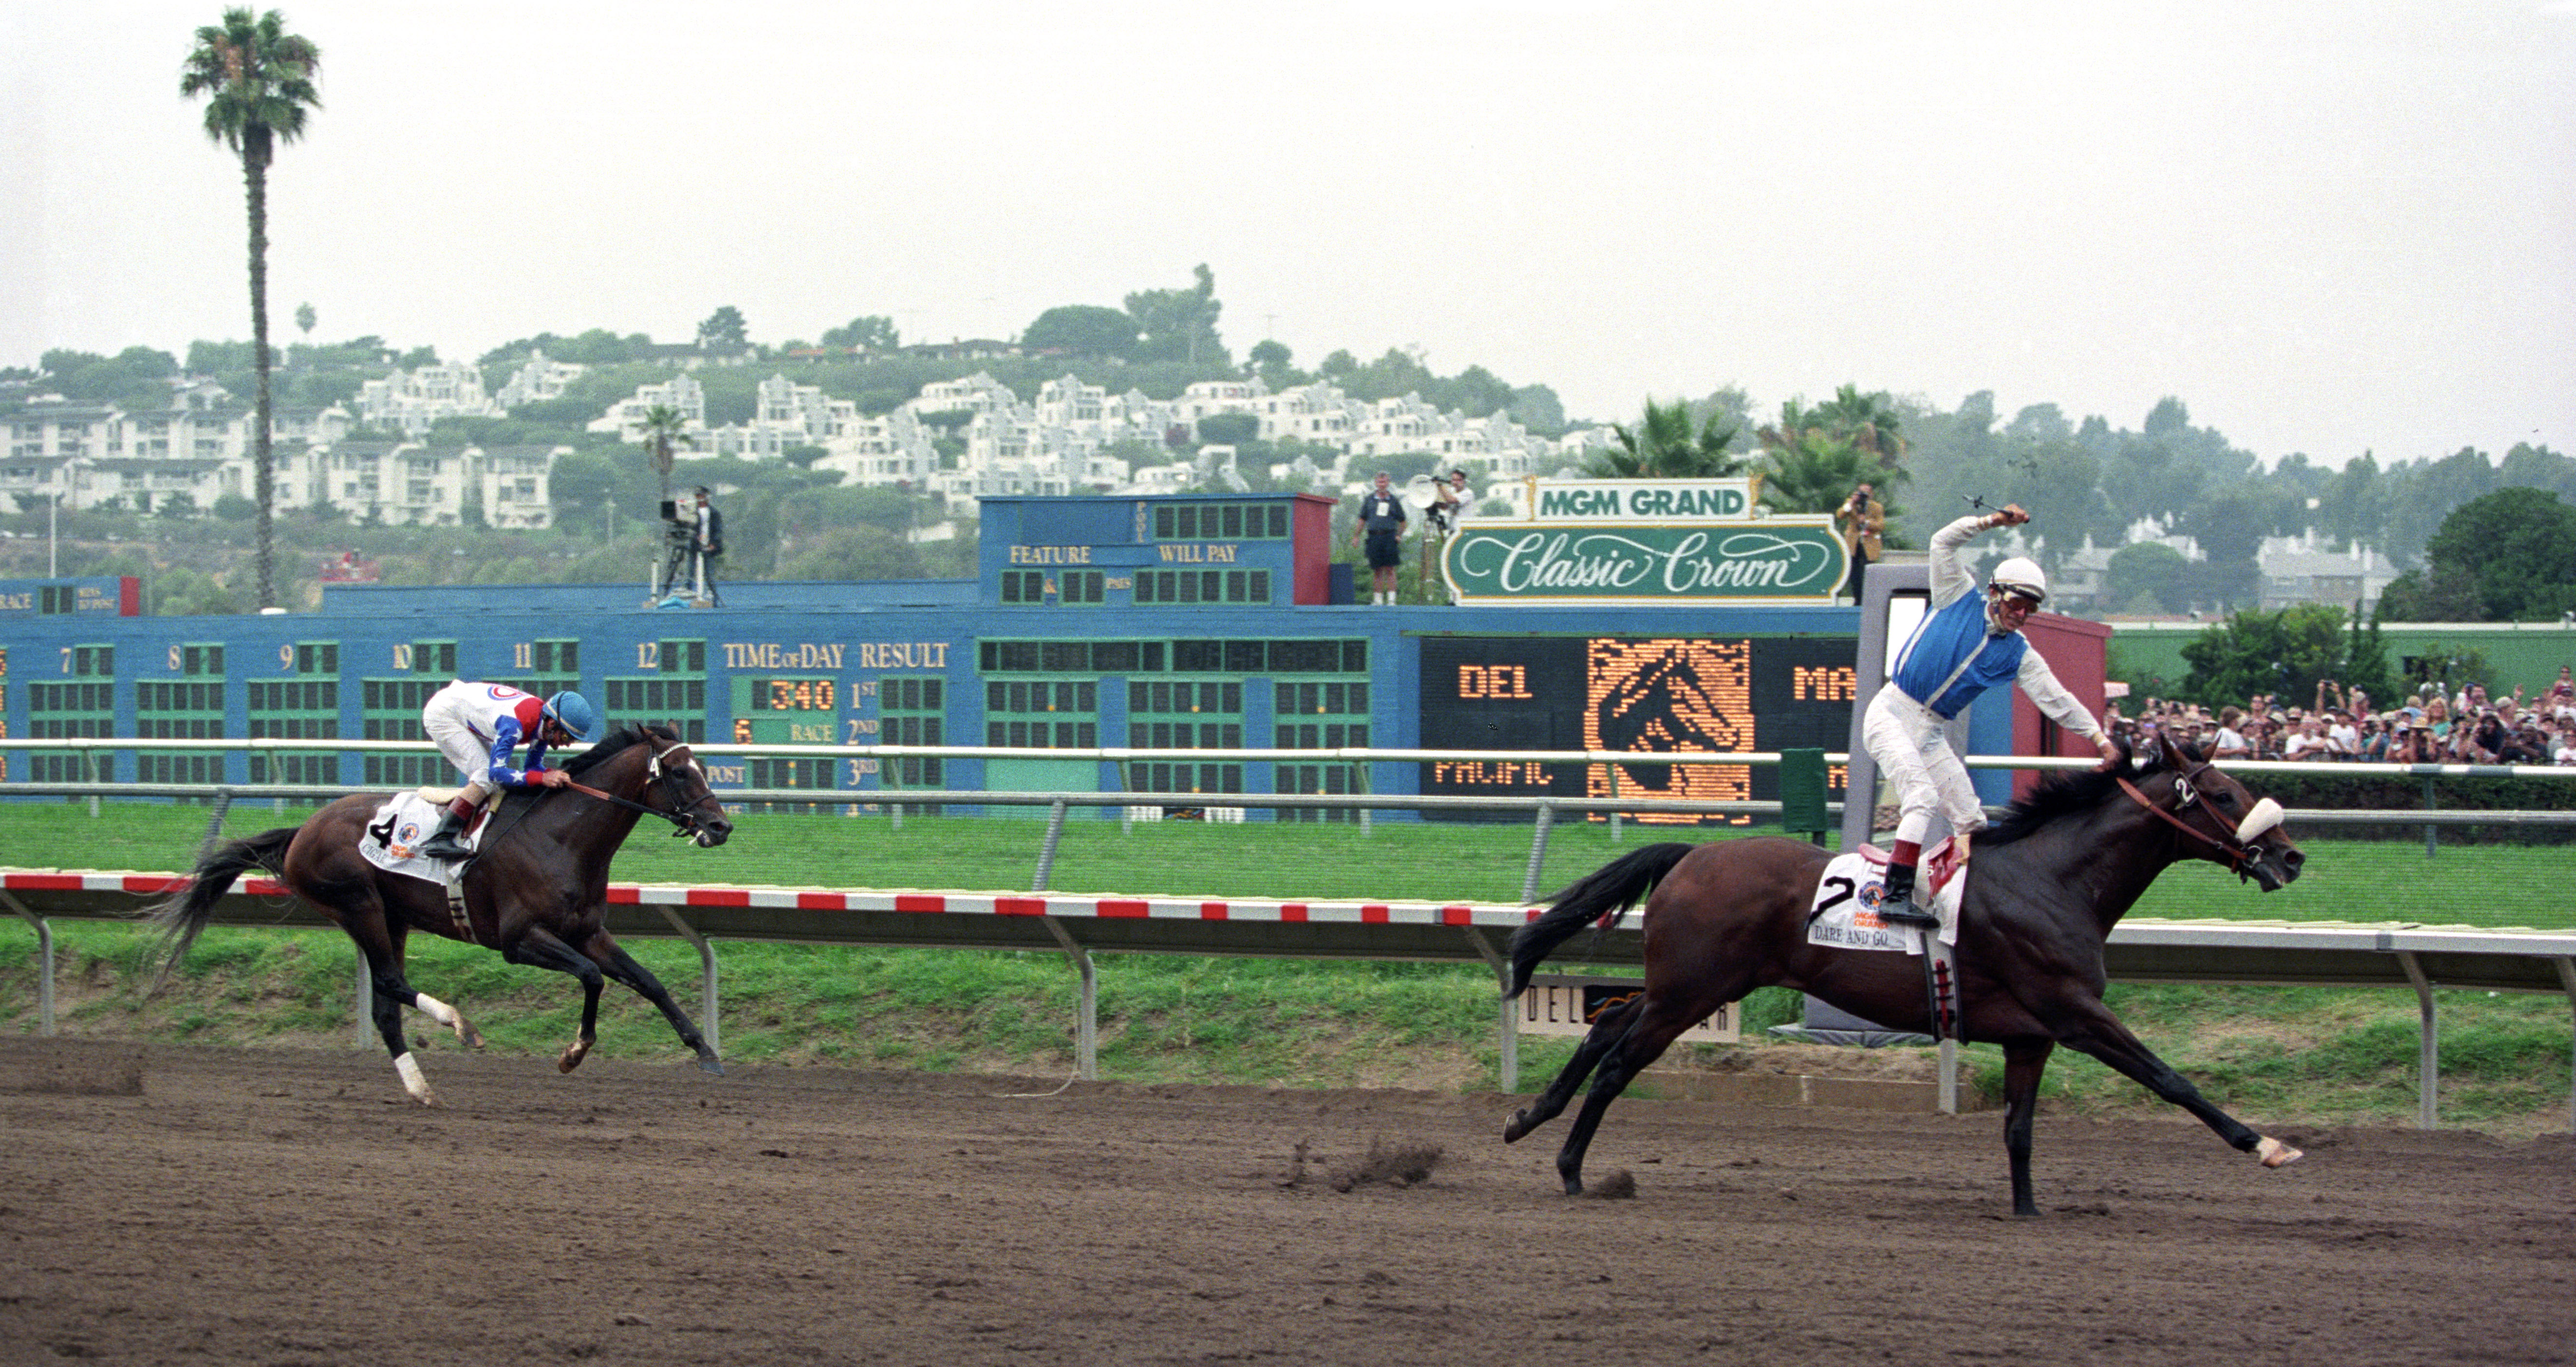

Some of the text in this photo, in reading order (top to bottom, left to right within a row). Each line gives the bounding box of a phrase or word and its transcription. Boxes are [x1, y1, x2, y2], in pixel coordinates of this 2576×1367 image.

[1540, 489, 1744, 516] MGM GRAND
[1135, 500, 1147, 544] POOL
[1010, 546, 1091, 564] FEATURE
[1159, 545, 1237, 563] WILL PAY
[1461, 533, 1829, 592] Classic Crown
[60, 648, 72, 673] 7
[168, 645, 181, 670] 8
[280, 645, 293, 669] 9
[393, 645, 412, 668] 10
[514, 644, 532, 668] 11
[637, 643, 657, 668] 12
[860, 643, 949, 667] RESULT
[1460, 665, 1533, 698] DEL
[1794, 667, 1856, 700] MA
[771, 681, 834, 709] 3:40
[852, 682, 877, 708] 1ST
[735, 720, 752, 745] 6
[791, 724, 833, 741] RACE
[847, 719, 878, 746] 2ND
[650, 757, 660, 776] 4
[708, 766, 745, 783] POST
[848, 759, 879, 785] 3RD
[2175, 778, 2197, 804] 2
[370, 813, 398, 850] 4
[1804, 876, 1856, 931] 2
[1814, 925, 1887, 945] DARE AND GO
[1528, 985, 1578, 1023] DEL
